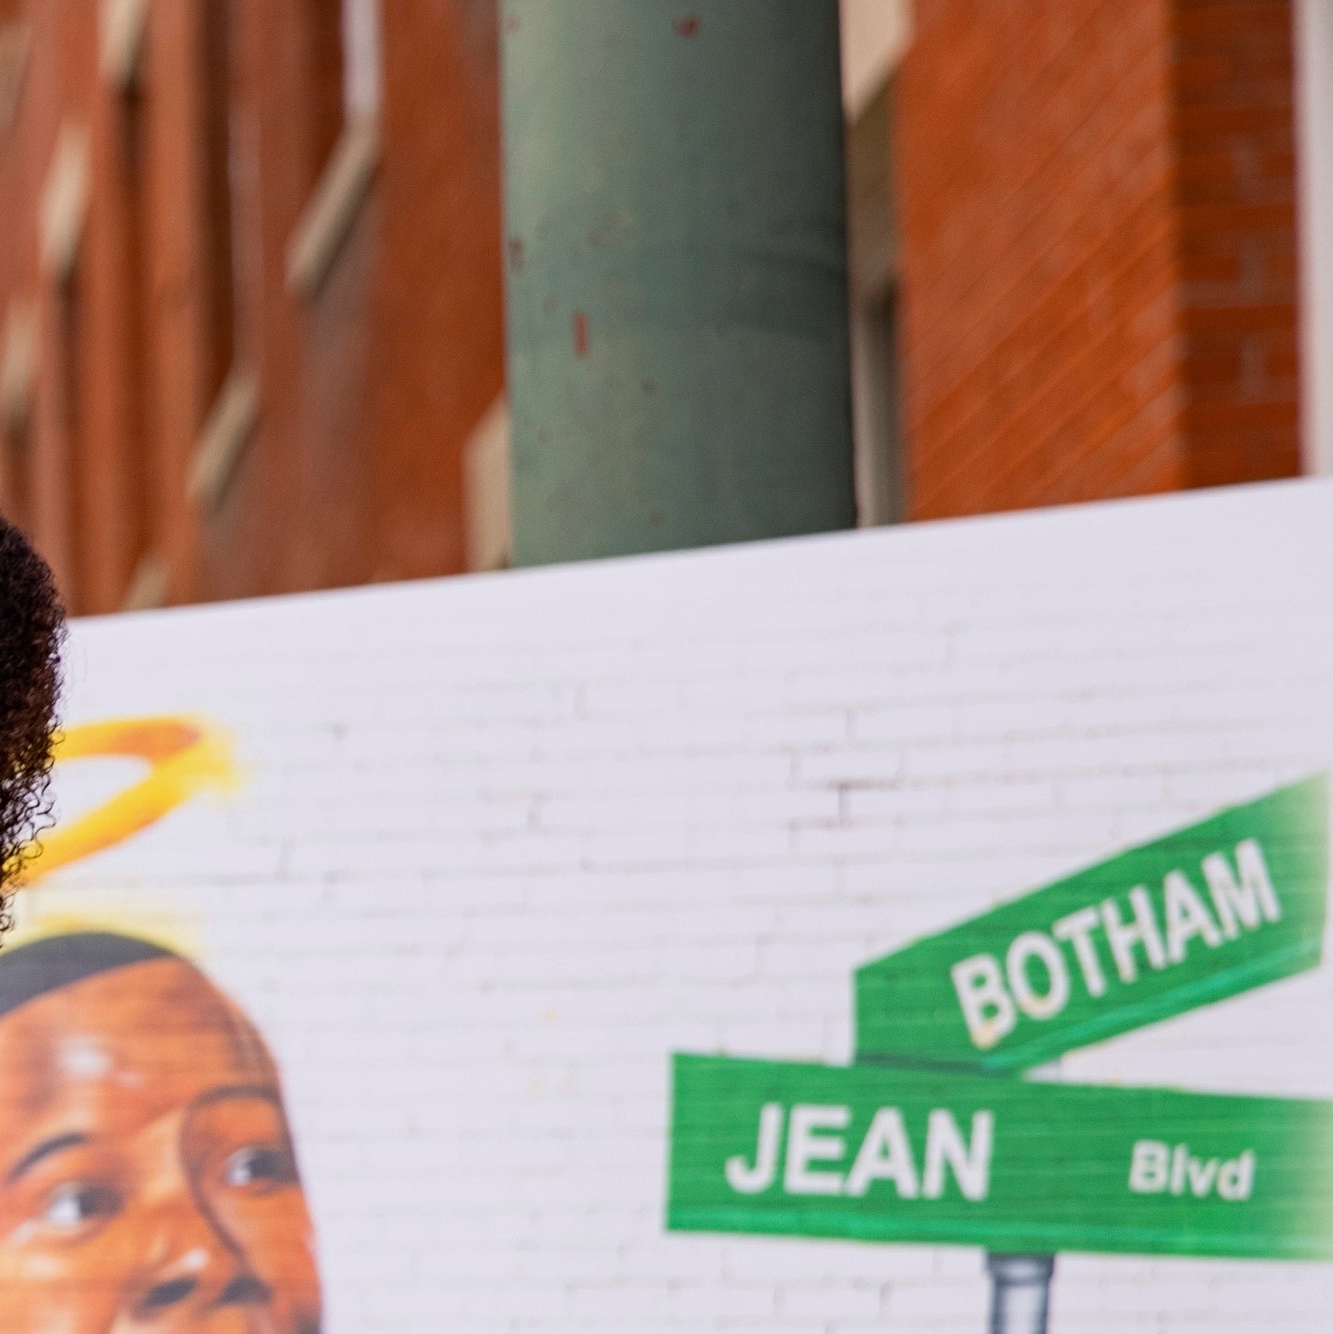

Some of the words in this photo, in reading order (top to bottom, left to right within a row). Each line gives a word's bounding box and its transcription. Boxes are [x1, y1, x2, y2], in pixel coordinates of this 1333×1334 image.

[950, 838, 1282, 1049] BOTHAM
[725, 1102, 994, 1201] JEAN
[1129, 1139, 1255, 1201] Blvd
